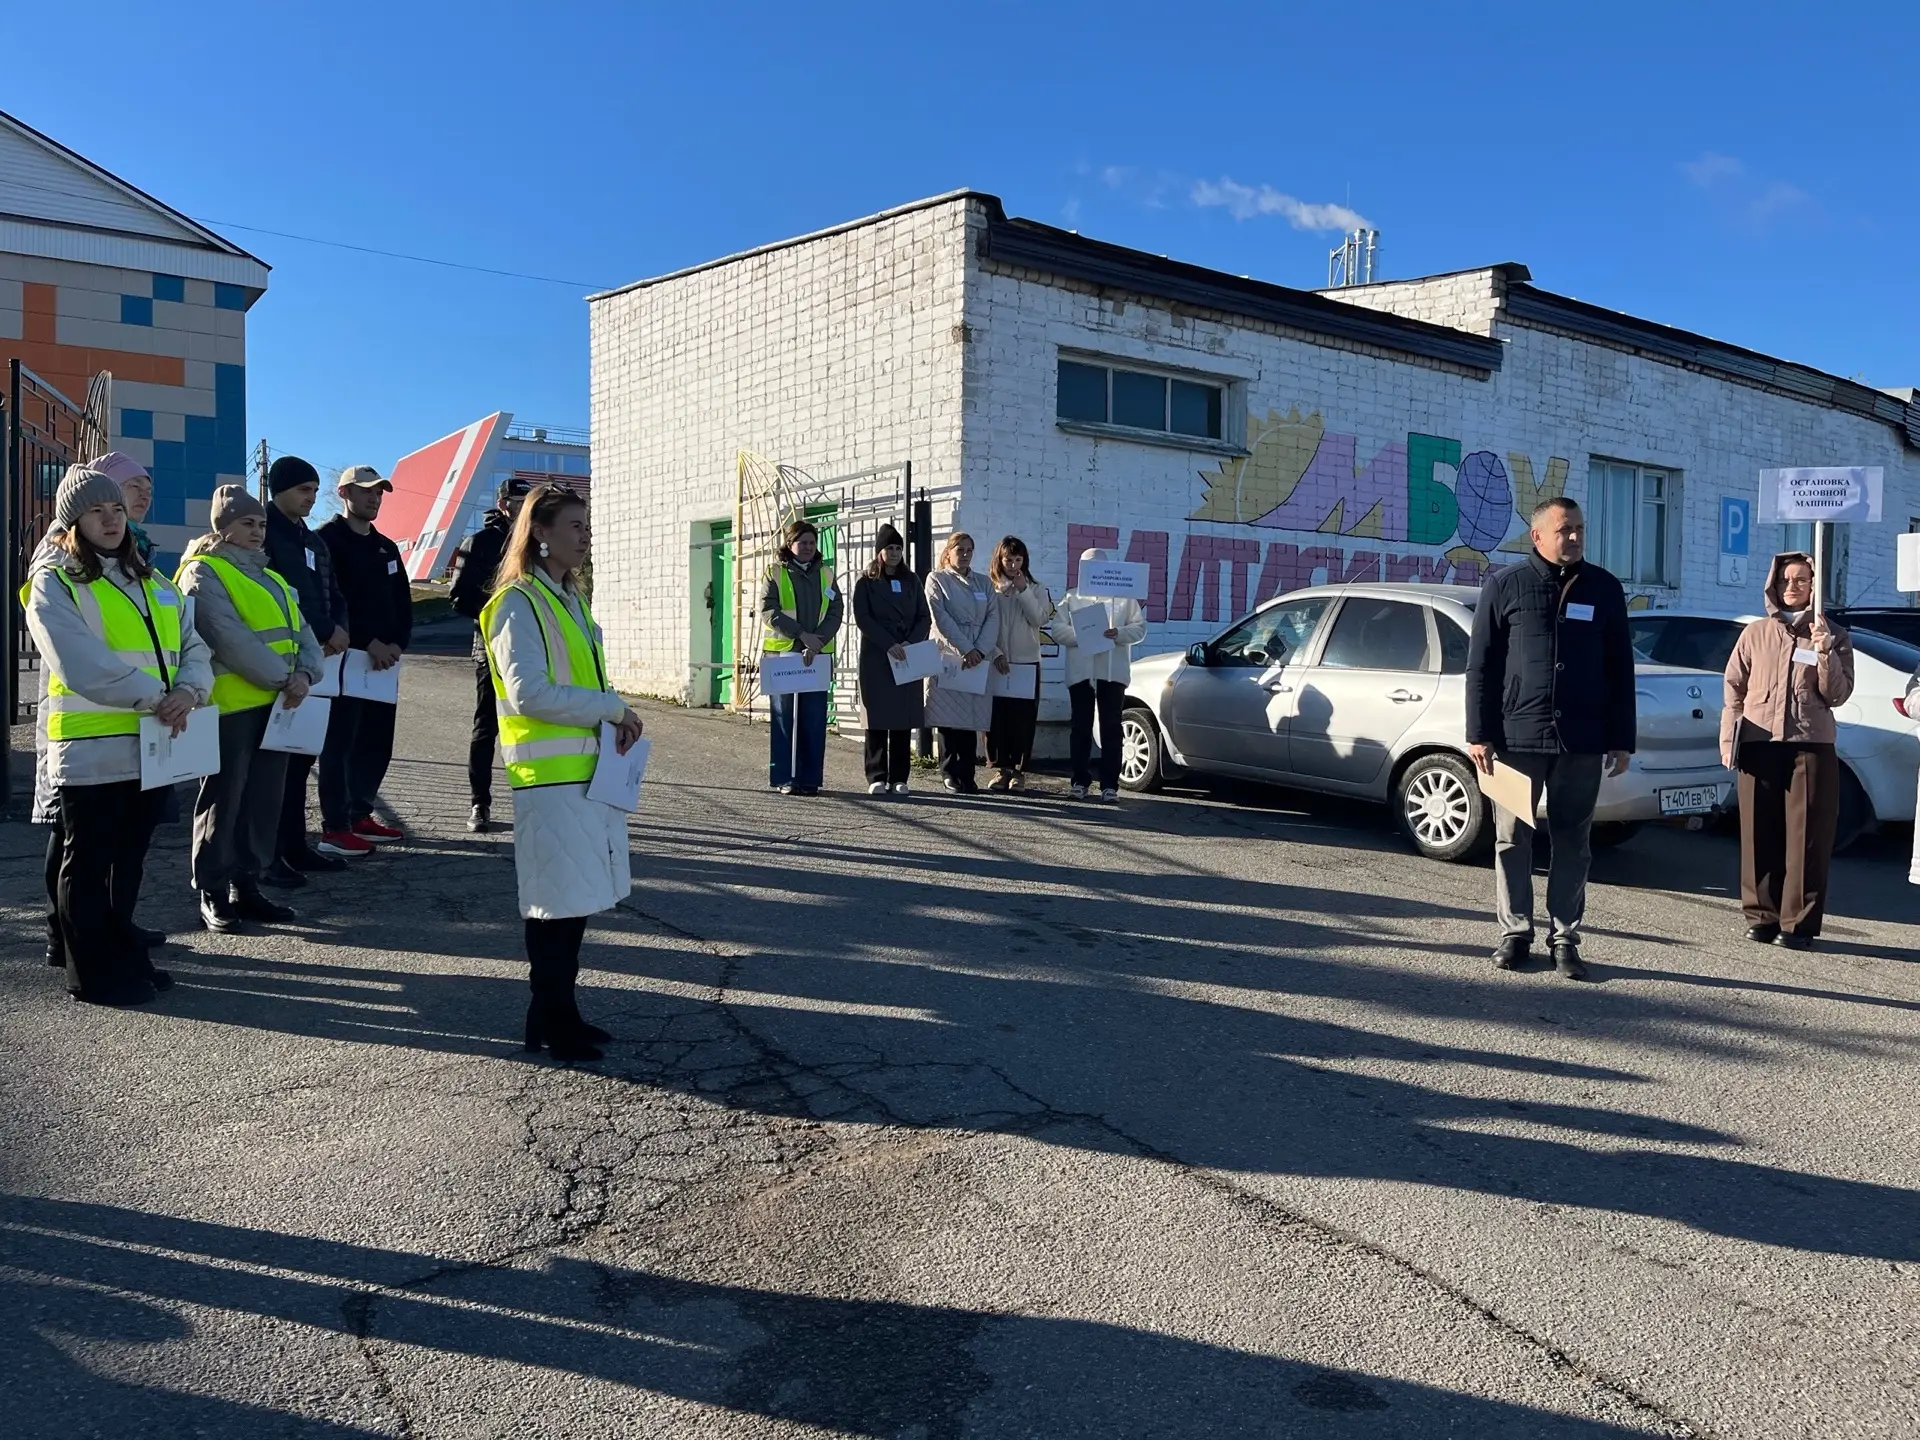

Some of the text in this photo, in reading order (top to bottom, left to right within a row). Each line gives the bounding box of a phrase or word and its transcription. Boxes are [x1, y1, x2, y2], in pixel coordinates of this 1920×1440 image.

[1248, 430, 1570, 553] МБОУ
[1792, 488, 1847, 497] ГОЛОВНОЙ
[1728, 504, 1744, 549] P
